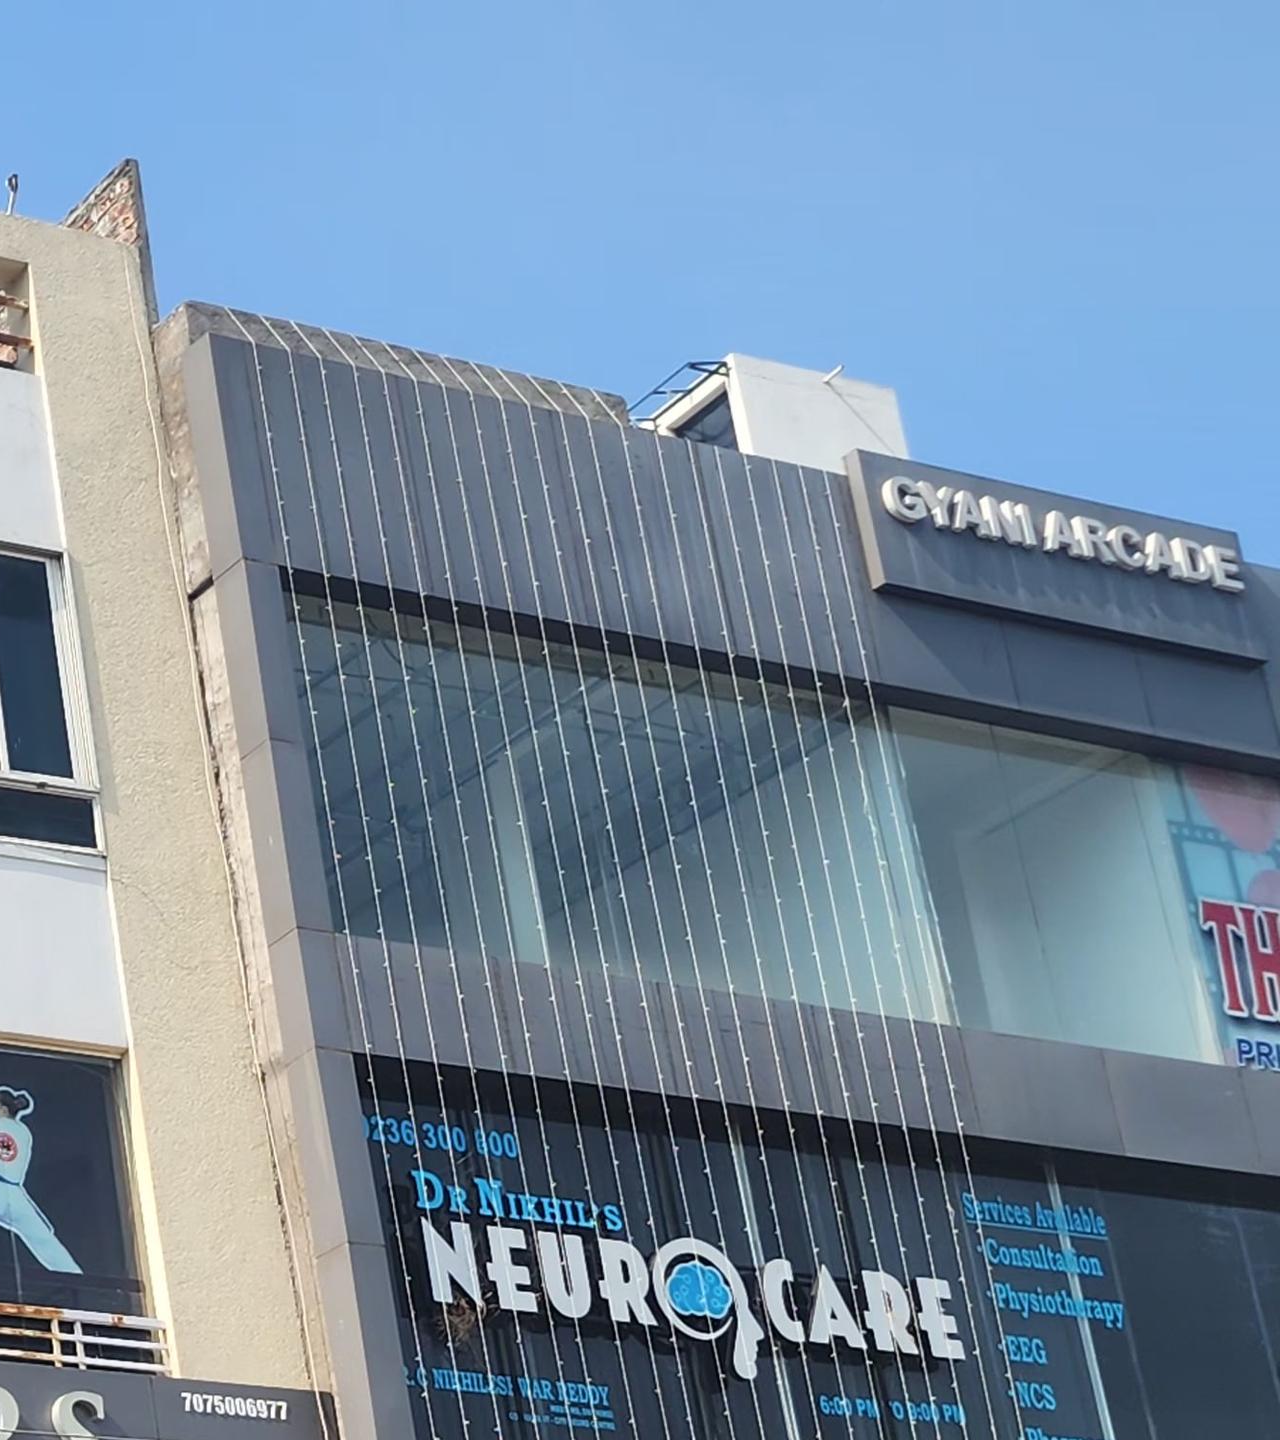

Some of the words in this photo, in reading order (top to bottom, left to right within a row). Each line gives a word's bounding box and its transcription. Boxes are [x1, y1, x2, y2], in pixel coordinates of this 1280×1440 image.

[881, 475, 1038, 550] GYANI
[1042, 510, 1245, 593] ARCADE
[963, 1191, 1031, 1226] Services
[986, 1238, 1104, 1276] Consultation
[994, 1283, 1124, 1330] Physiotherapy
[1007, 1336, 1047, 1365] EEG
[180, 1390, 289, 1422] 7075006977
[1015, 1381, 1056, 1410] NCS
